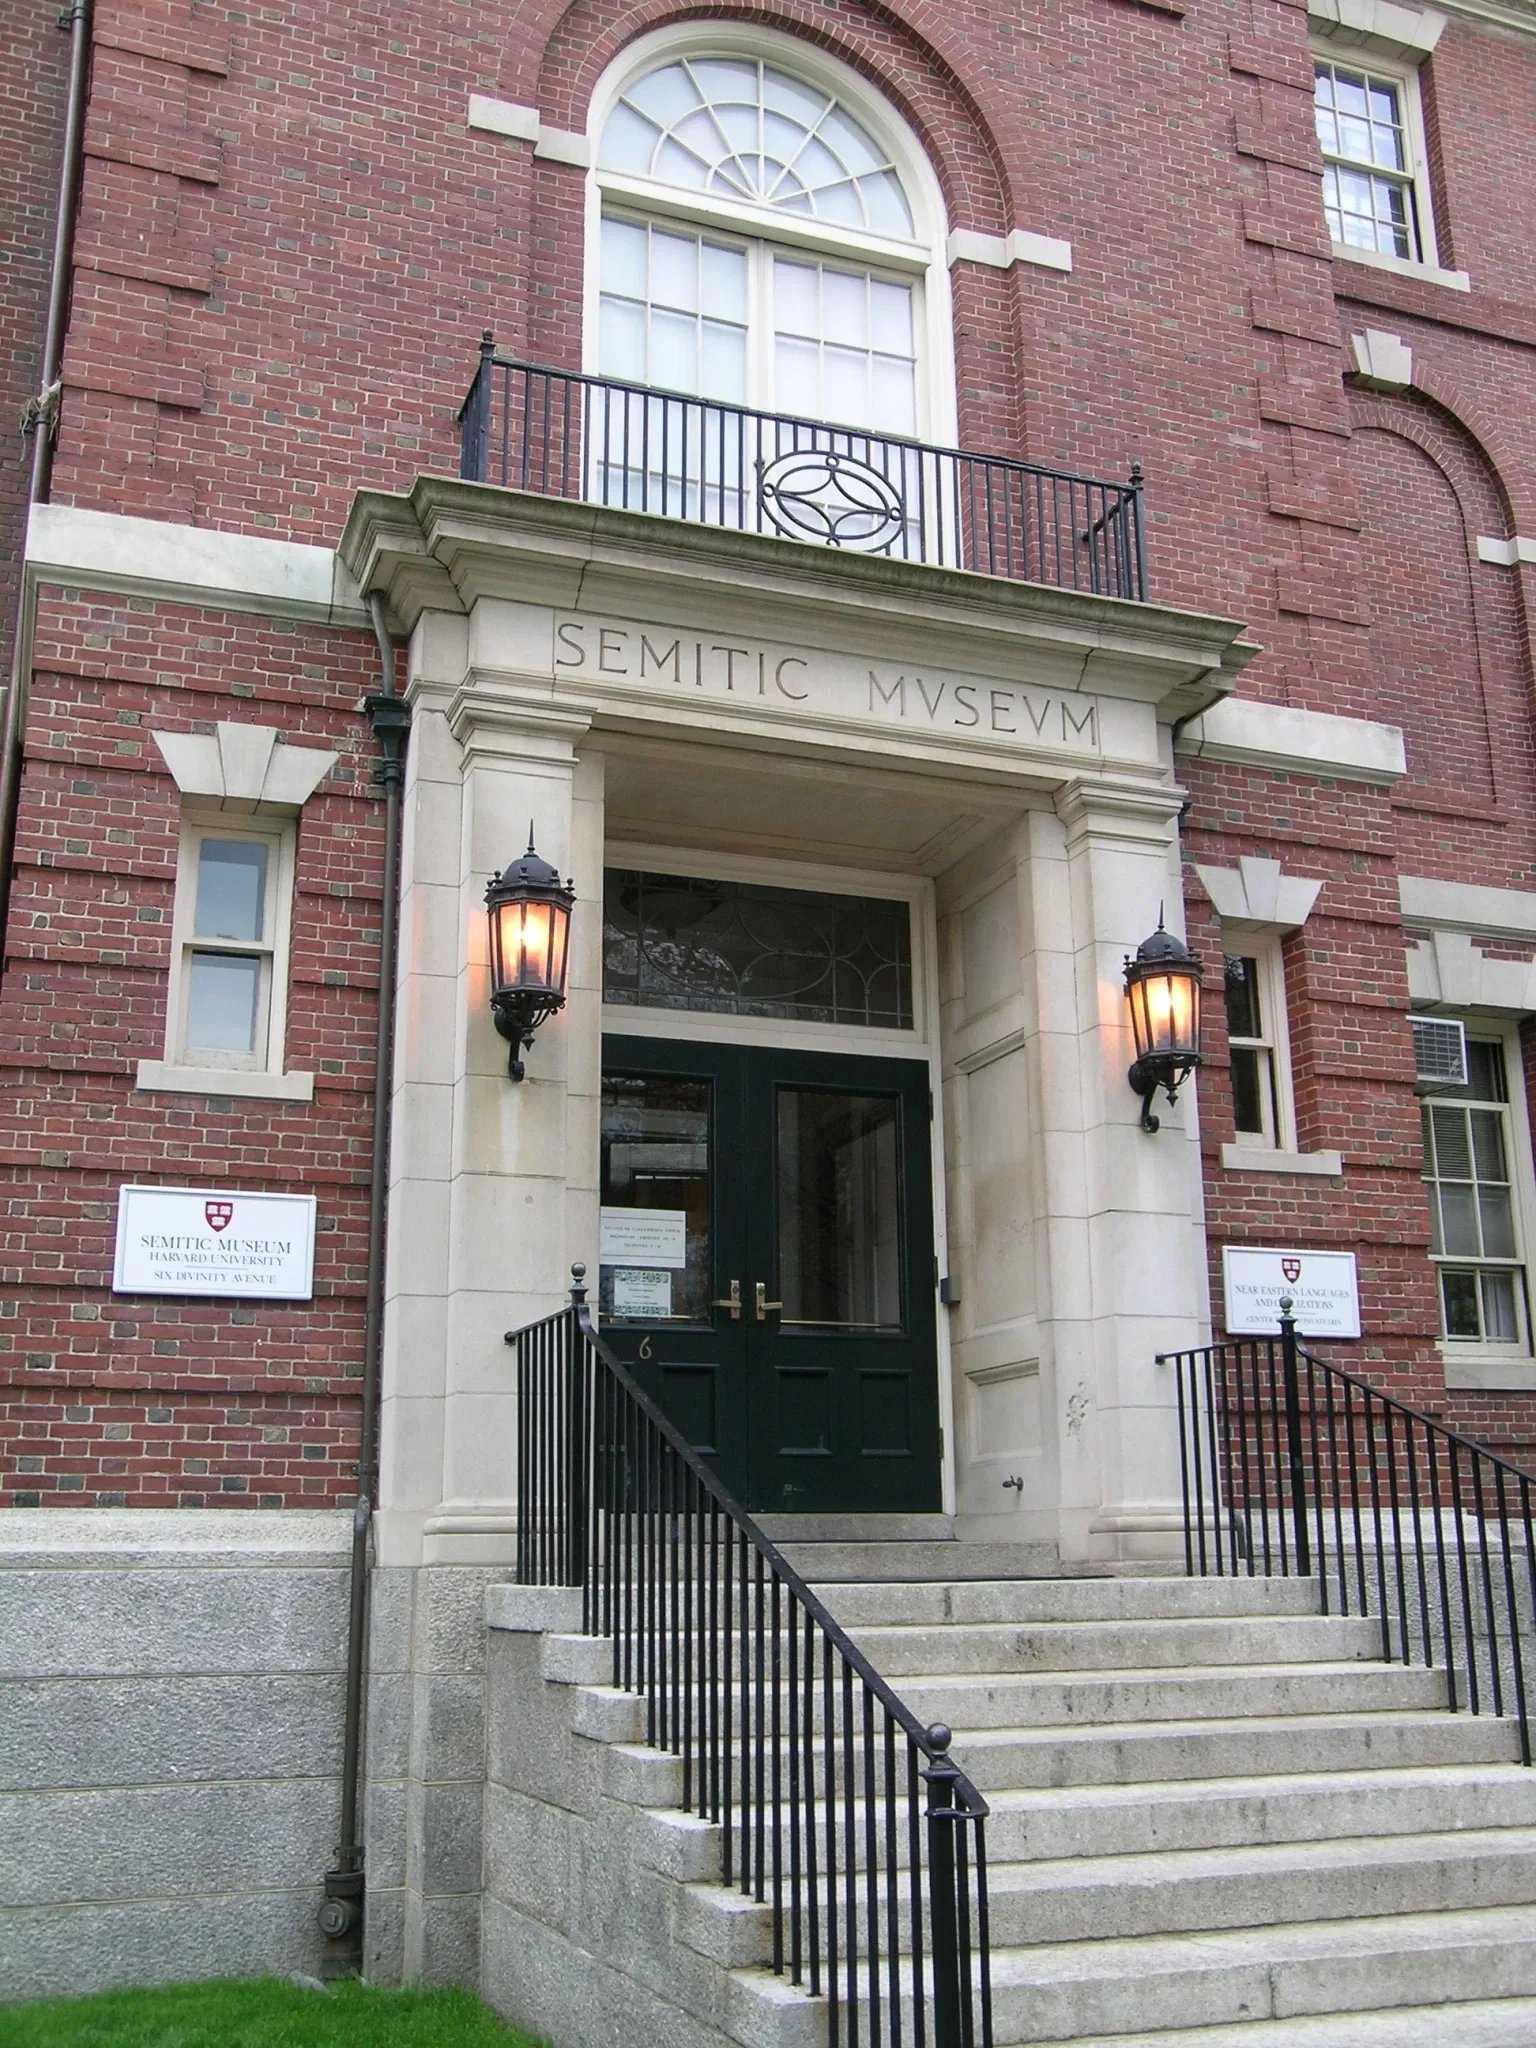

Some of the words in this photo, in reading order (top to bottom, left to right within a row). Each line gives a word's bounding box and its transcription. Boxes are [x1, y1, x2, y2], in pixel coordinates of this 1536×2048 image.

[555, 623, 809, 701] SEMITIC
[868, 670, 1098, 746] MVSEVM
[140, 1235, 211, 1250] SEMITIC
[218, 1238, 291, 1254] MUSEUM
[149, 1251, 207, 1263] HARVARD
[211, 1254, 284, 1266] UNIVERSITY
[154, 1270, 172, 1280] SIX
[176, 1271, 228, 1282] DIVINITY
[232, 1274, 276, 1284] AVENUE
[1235, 1285, 1259, 1295] NEAR
[1261, 1286, 1298, 1297] EASTERN
[1301, 1288, 1350, 1299] LANGUAGES
[1255, 1298, 1273, 1307] AND
[1274, 1299, 1334, 1310] CLIZATIONS
[639, 1336, 652, 1360] 6
